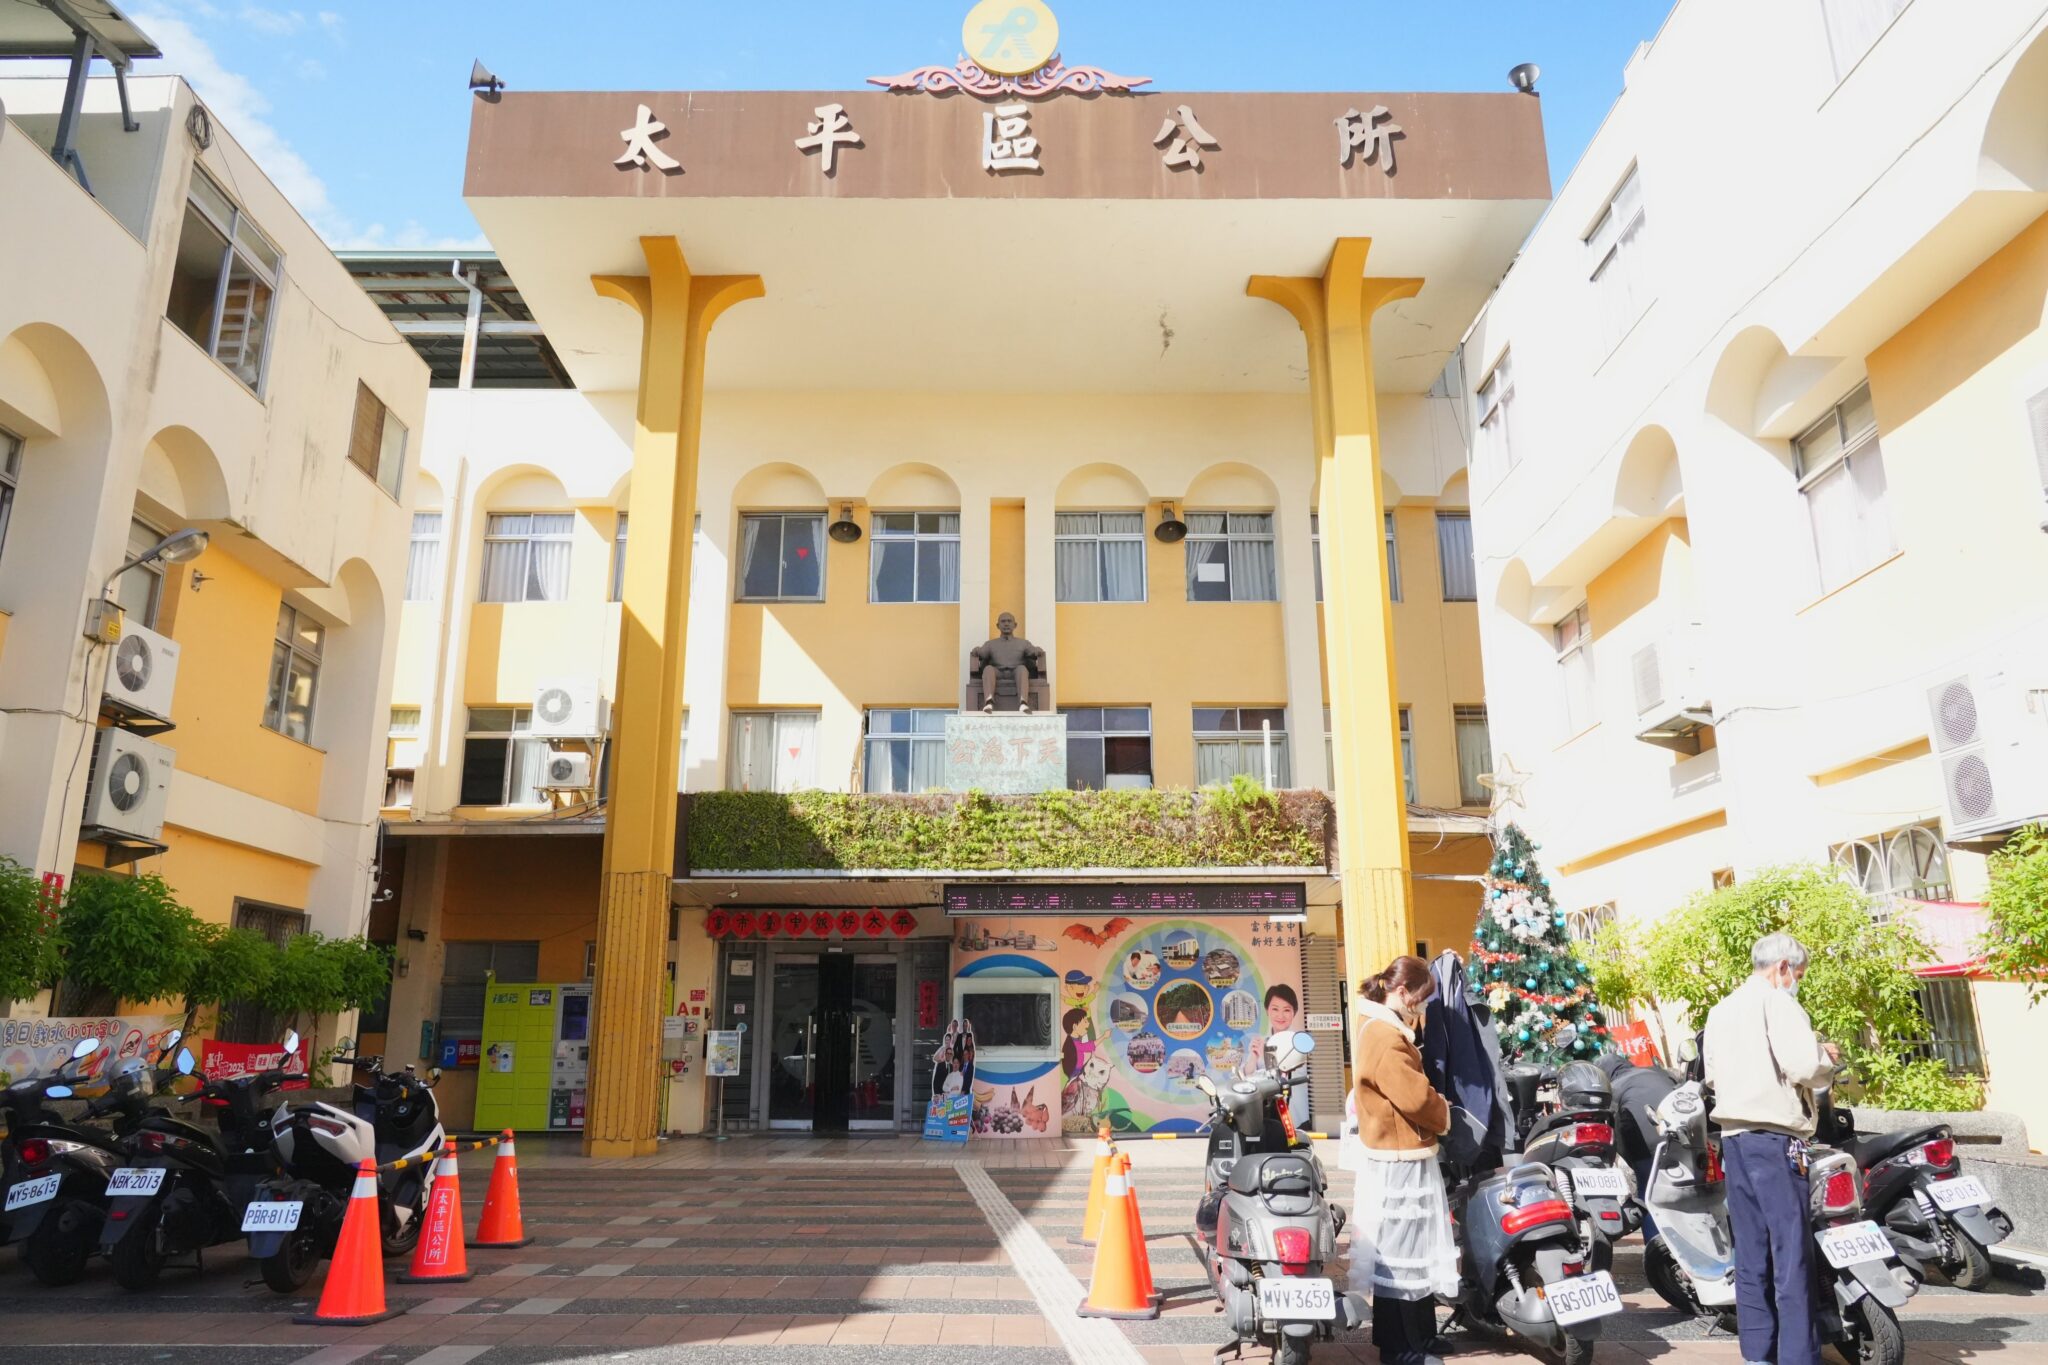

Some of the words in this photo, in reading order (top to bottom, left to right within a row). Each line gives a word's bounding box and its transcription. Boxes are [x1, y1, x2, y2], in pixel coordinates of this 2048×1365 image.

[613, 103, 1406, 174] 太平區公所
[1250, 921, 1296, 932] 富市臺中
[1251, 936, 1297, 947] 新好生活
[444, 1046, 456, 1060] P
[109, 1174, 160, 1189] NBK-2013
[8, 1180, 57, 1205] MYS-8615
[245, 1209, 300, 1224] PBR-8115
[428, 1191, 449, 1260] 太平區公所
[1826, 1232, 1890, 1262] 159-BWX
[1263, 1289, 1331, 1309] MVV-3659
[1551, 1282, 1616, 1315] EQS-0706
